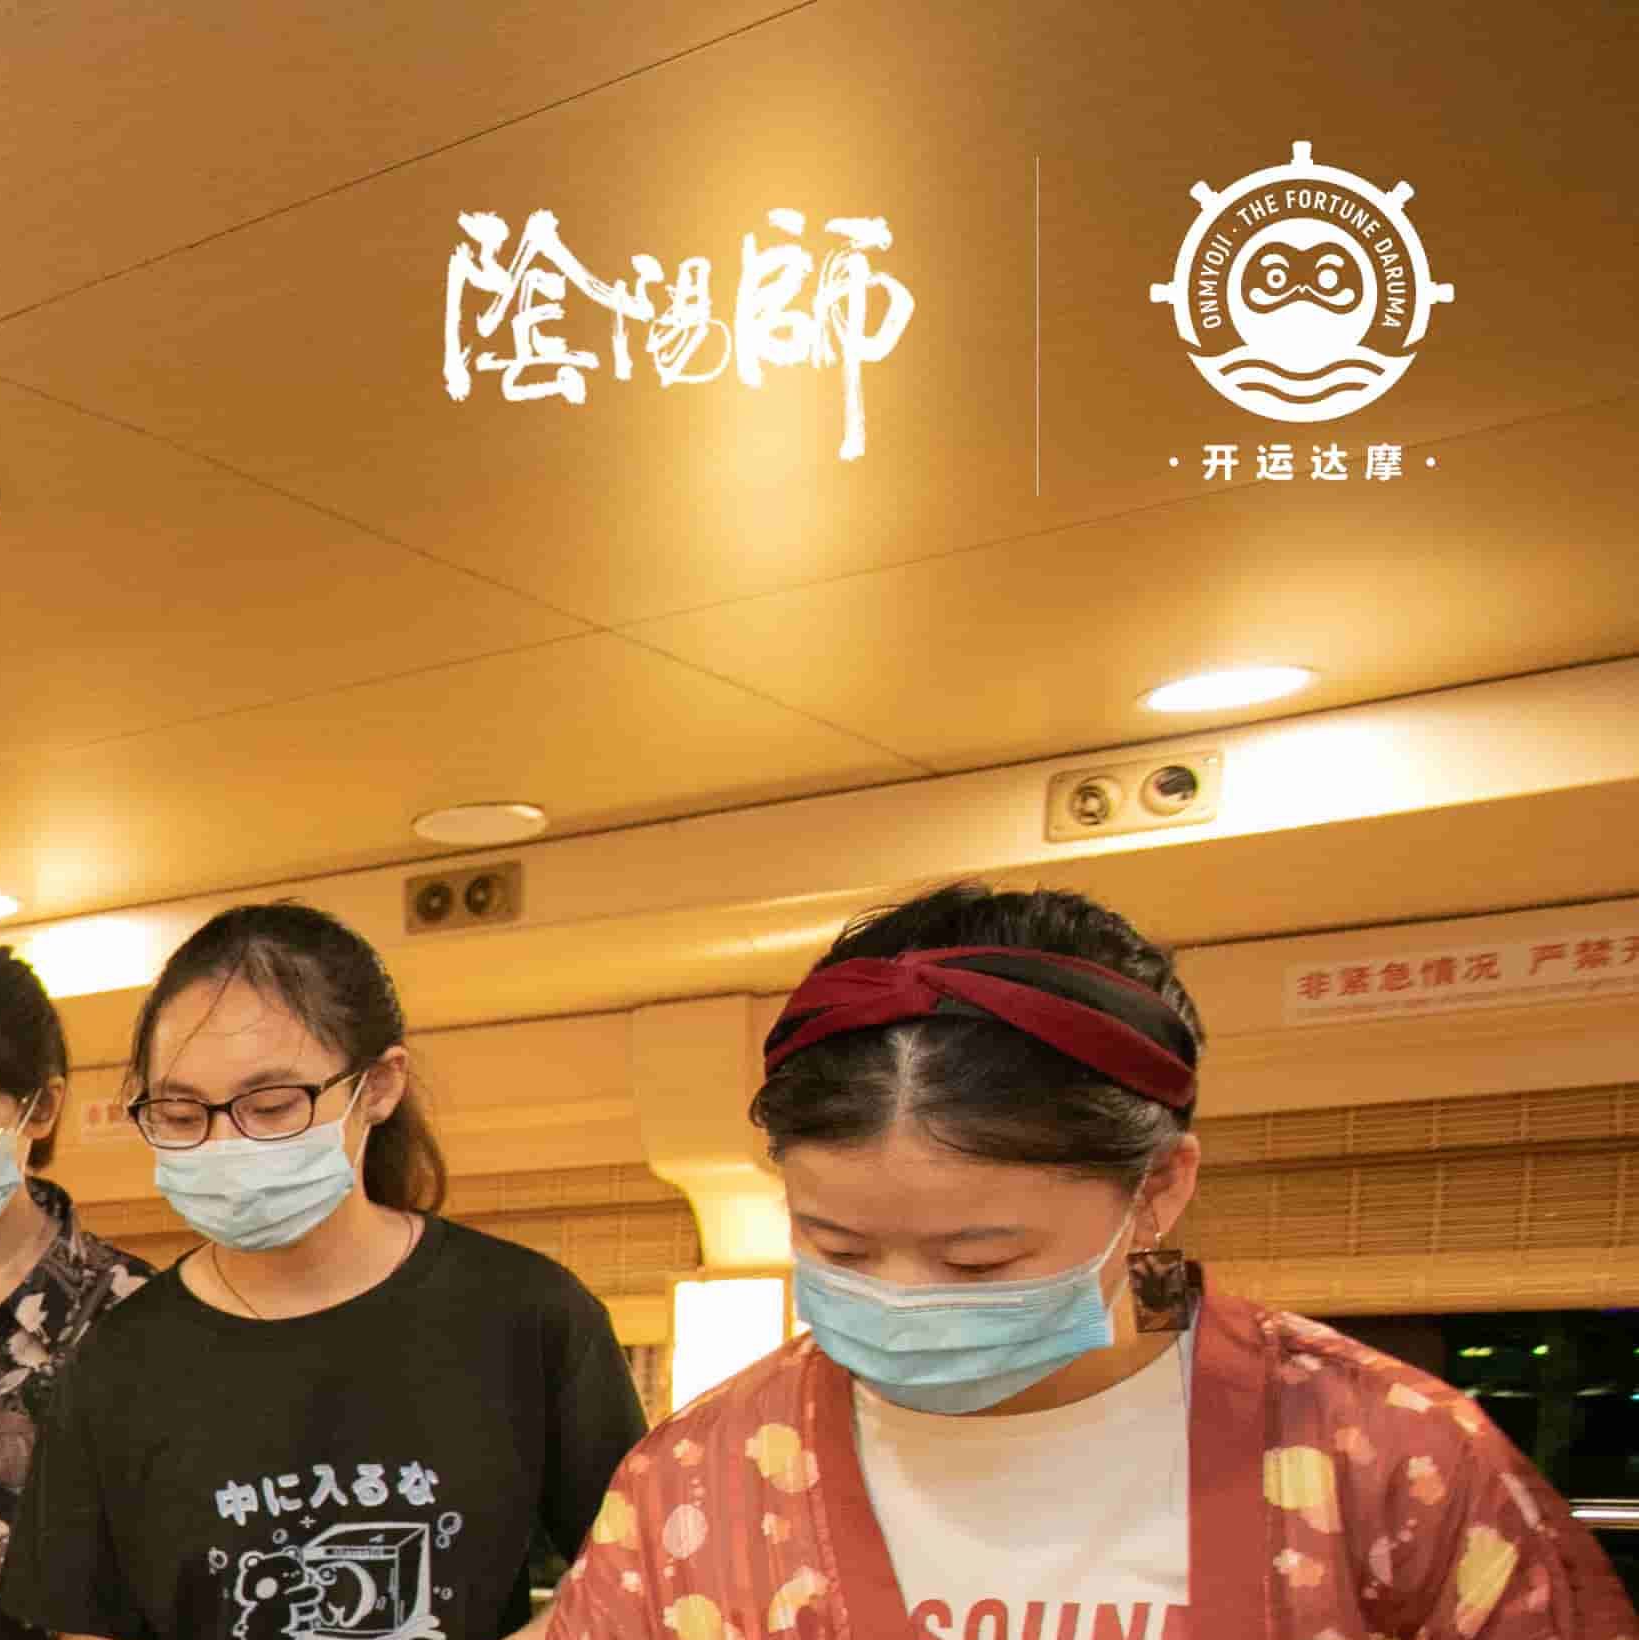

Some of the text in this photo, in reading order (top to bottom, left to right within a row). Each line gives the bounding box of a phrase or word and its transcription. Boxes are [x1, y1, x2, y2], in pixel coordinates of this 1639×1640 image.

[1296, 951, 1503, 1001] 非紧急情况
[214, 1460, 440, 1527] 中に入るな
